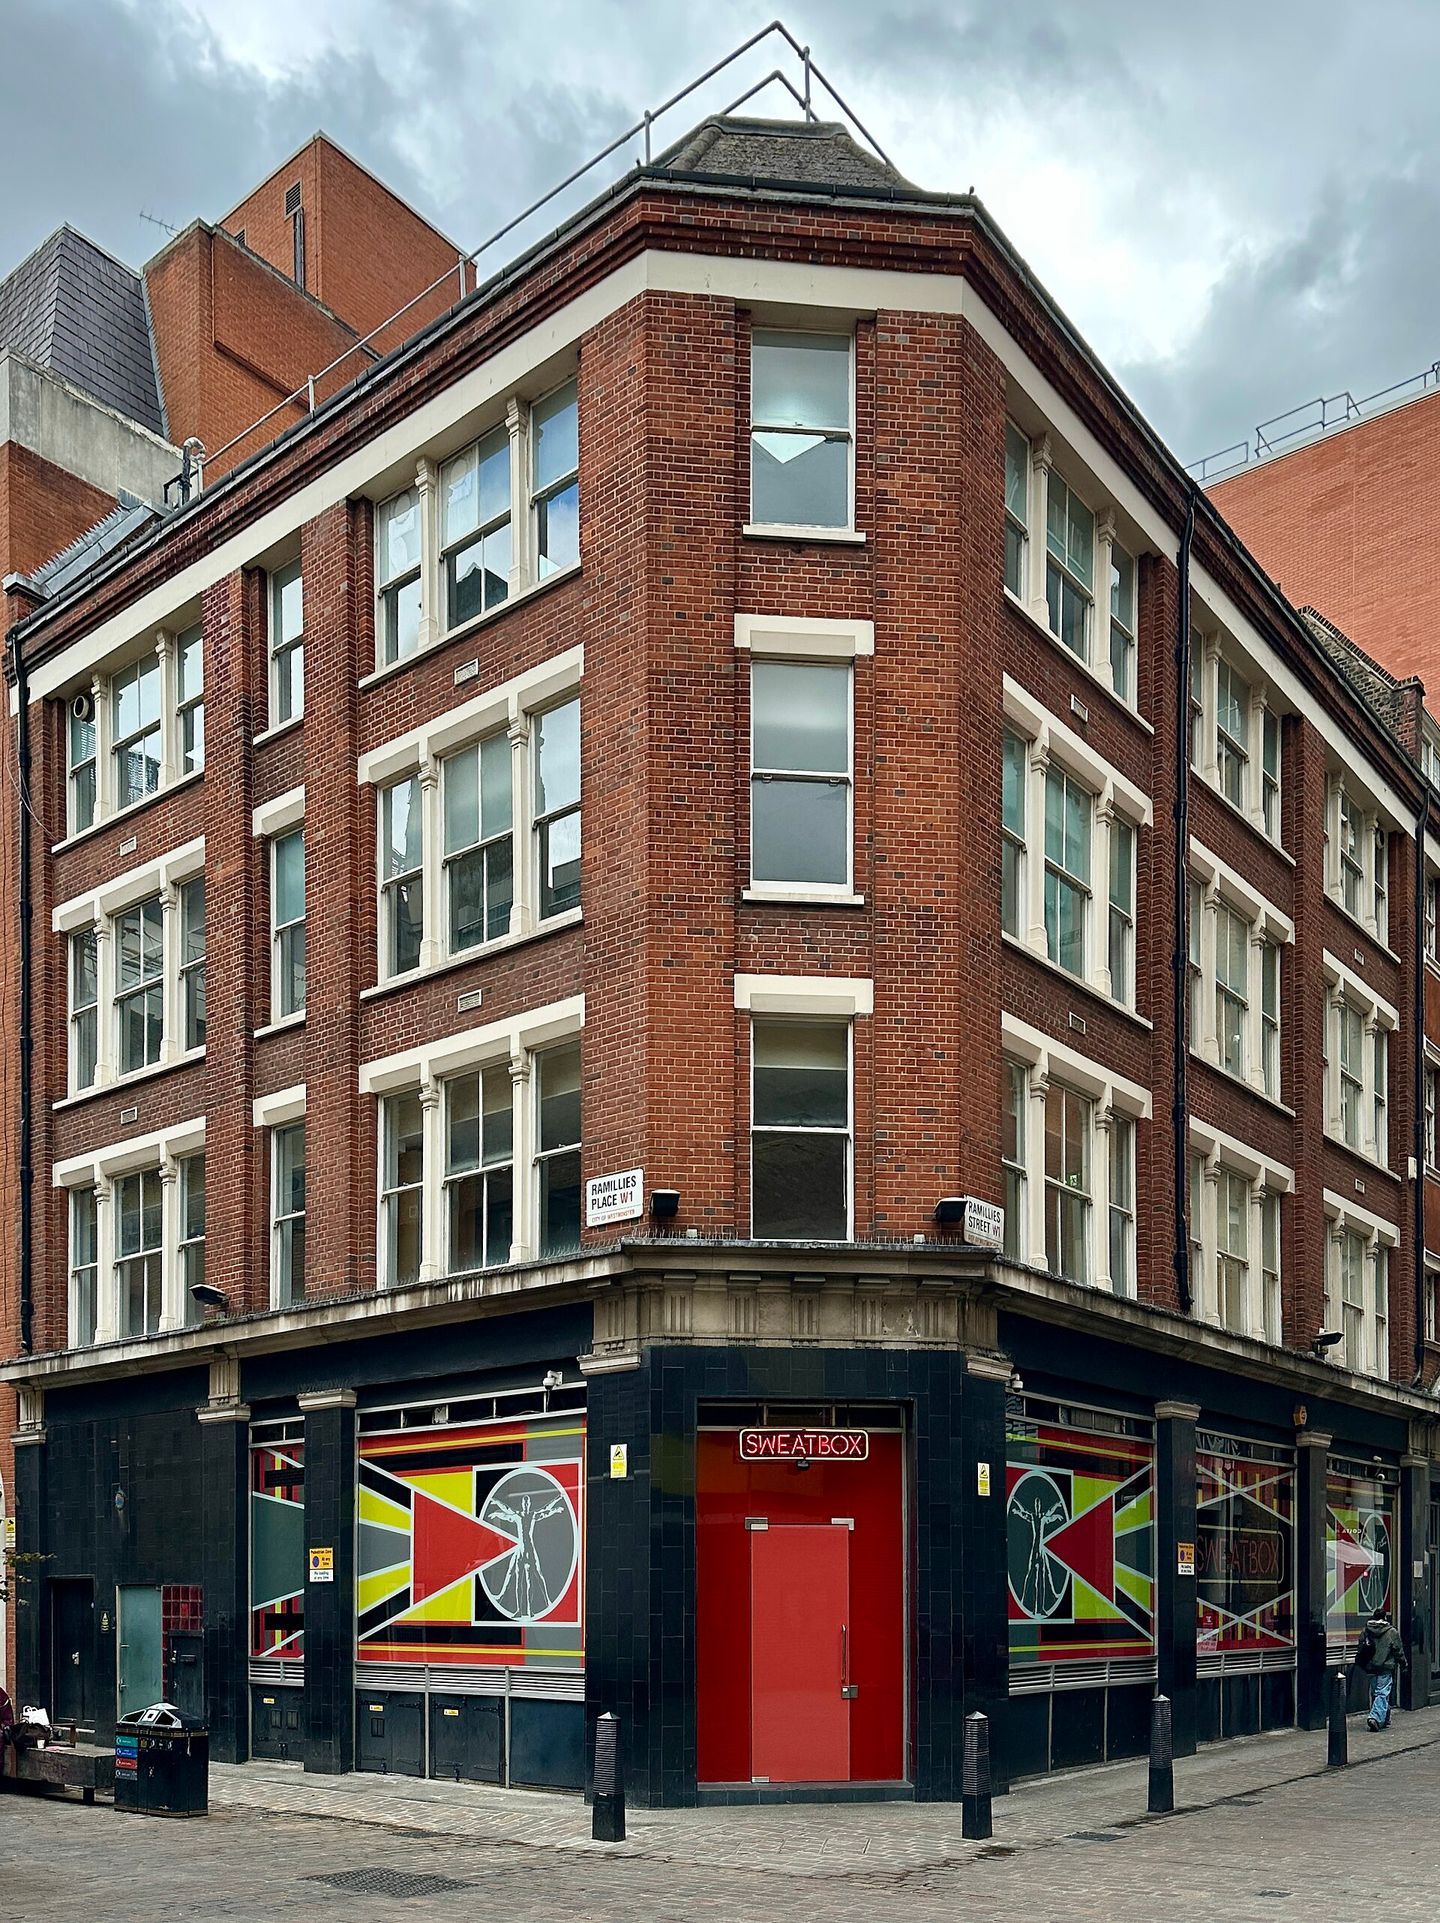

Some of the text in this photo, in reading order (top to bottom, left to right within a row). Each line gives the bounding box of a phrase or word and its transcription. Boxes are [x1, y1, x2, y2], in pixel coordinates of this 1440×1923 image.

[591, 1175, 637, 1196] RAMILLIES
[591, 1190, 633, 1210] PLACE W1
[968, 1200, 1001, 1224] RAMILLIES
[968, 1215, 1001, 1238] STREET W1
[746, 1433, 862, 1455] SWEATBOX
[1196, 1535, 1279, 1574] SWEATBOX
